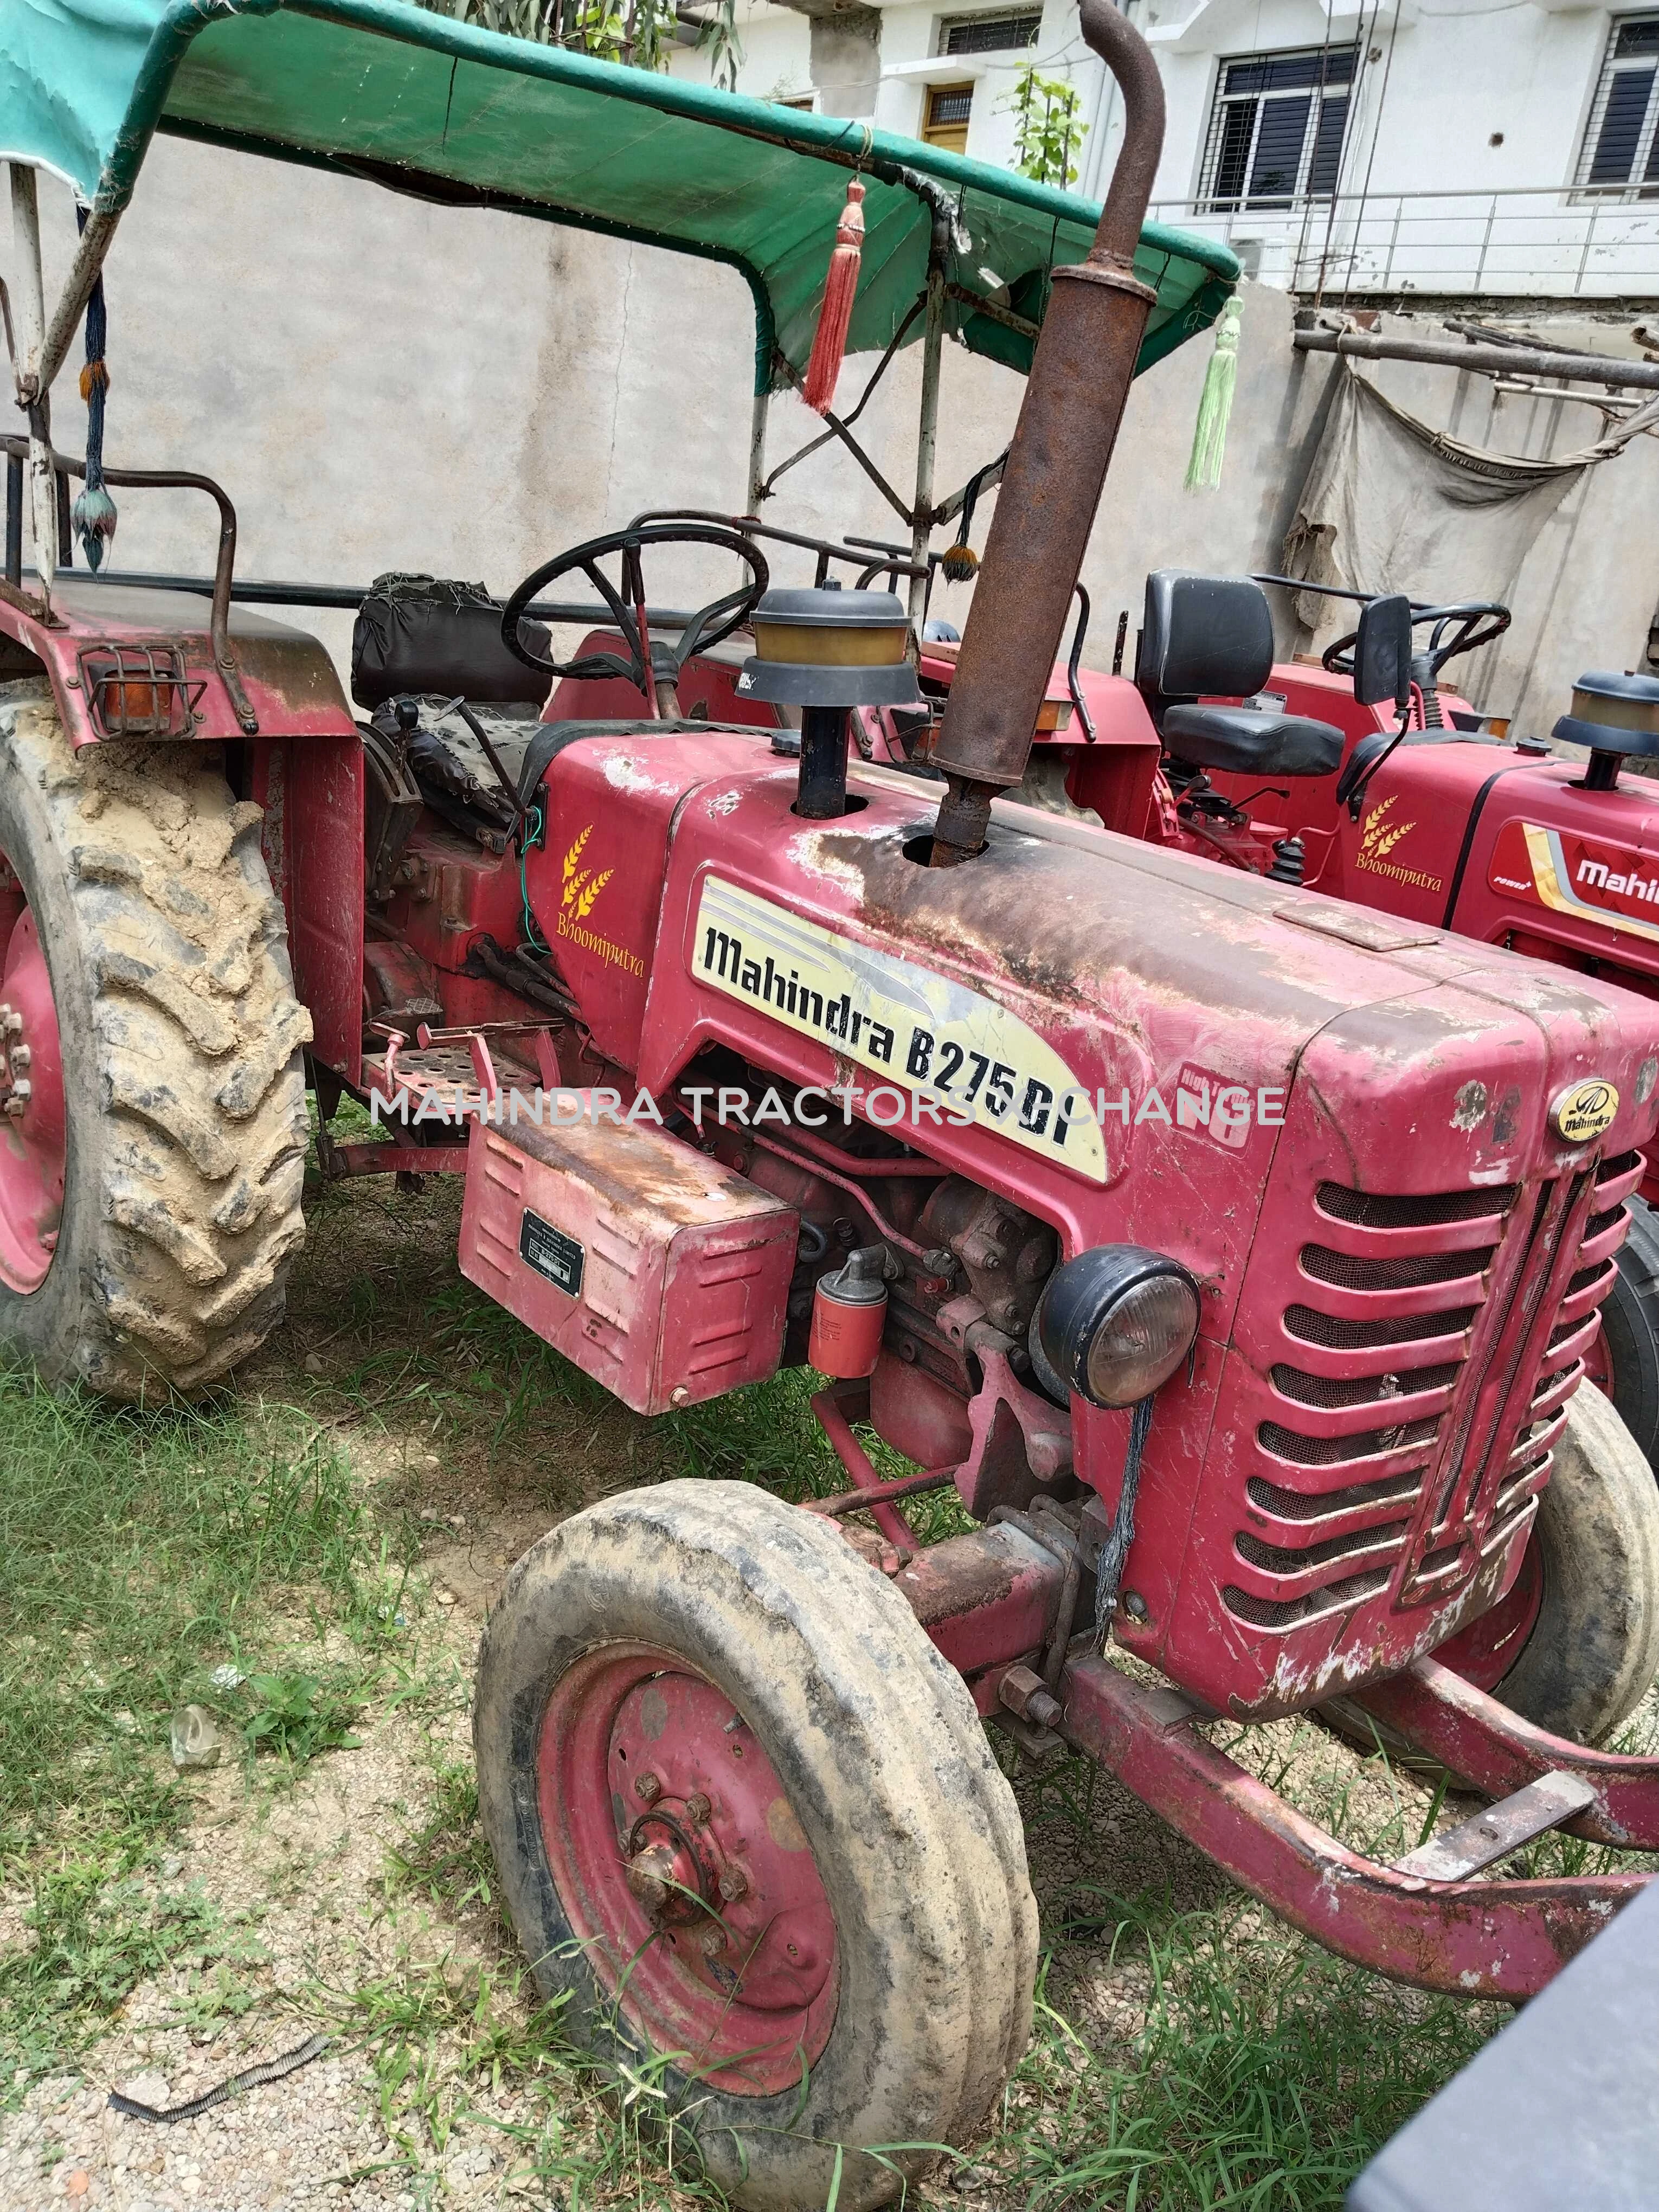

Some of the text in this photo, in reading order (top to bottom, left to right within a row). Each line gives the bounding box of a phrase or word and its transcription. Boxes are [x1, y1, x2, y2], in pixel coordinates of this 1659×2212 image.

[1355, 852, 1442, 892] Bhoomiputra
[556, 912, 644, 978] Bhoomiputra
[704, 927, 895, 1064] Mahindra
[1181, 1068, 1210, 1092] High
[1564, 1114, 1611, 1133] Mahindra
